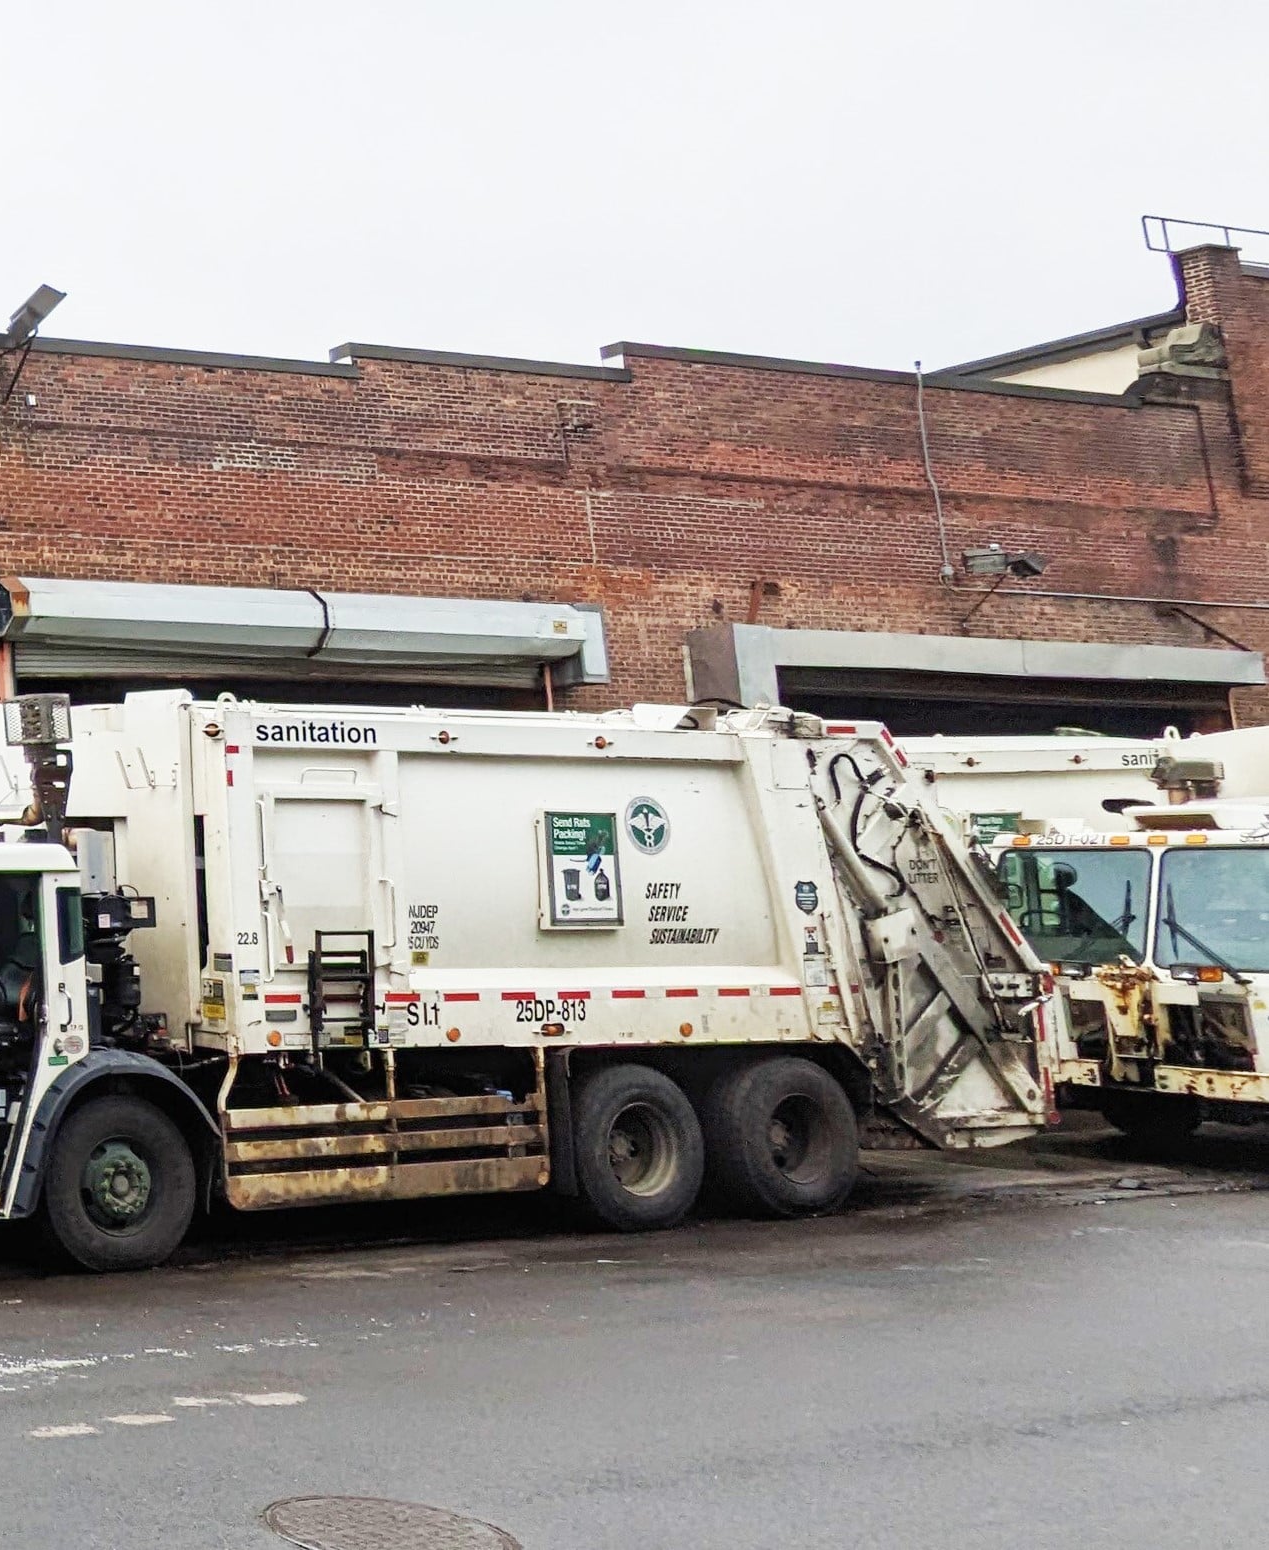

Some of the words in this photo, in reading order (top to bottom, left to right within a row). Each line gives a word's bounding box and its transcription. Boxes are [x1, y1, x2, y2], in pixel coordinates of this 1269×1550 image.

[256, 720, 377, 744] sanitation
[553, 816, 572, 827] Send
[553, 828, 587, 841] Packing!
[645, 882, 681, 899] SAFETY
[408, 904, 439, 918] NJDEP
[648, 905, 689, 922] SERVICE
[410, 920, 436, 934] 20947
[237, 932, 259, 945] 22.8
[649, 928, 720, 944] SUSTAINABILITY
[516, 999, 586, 1022] 25DP-813
